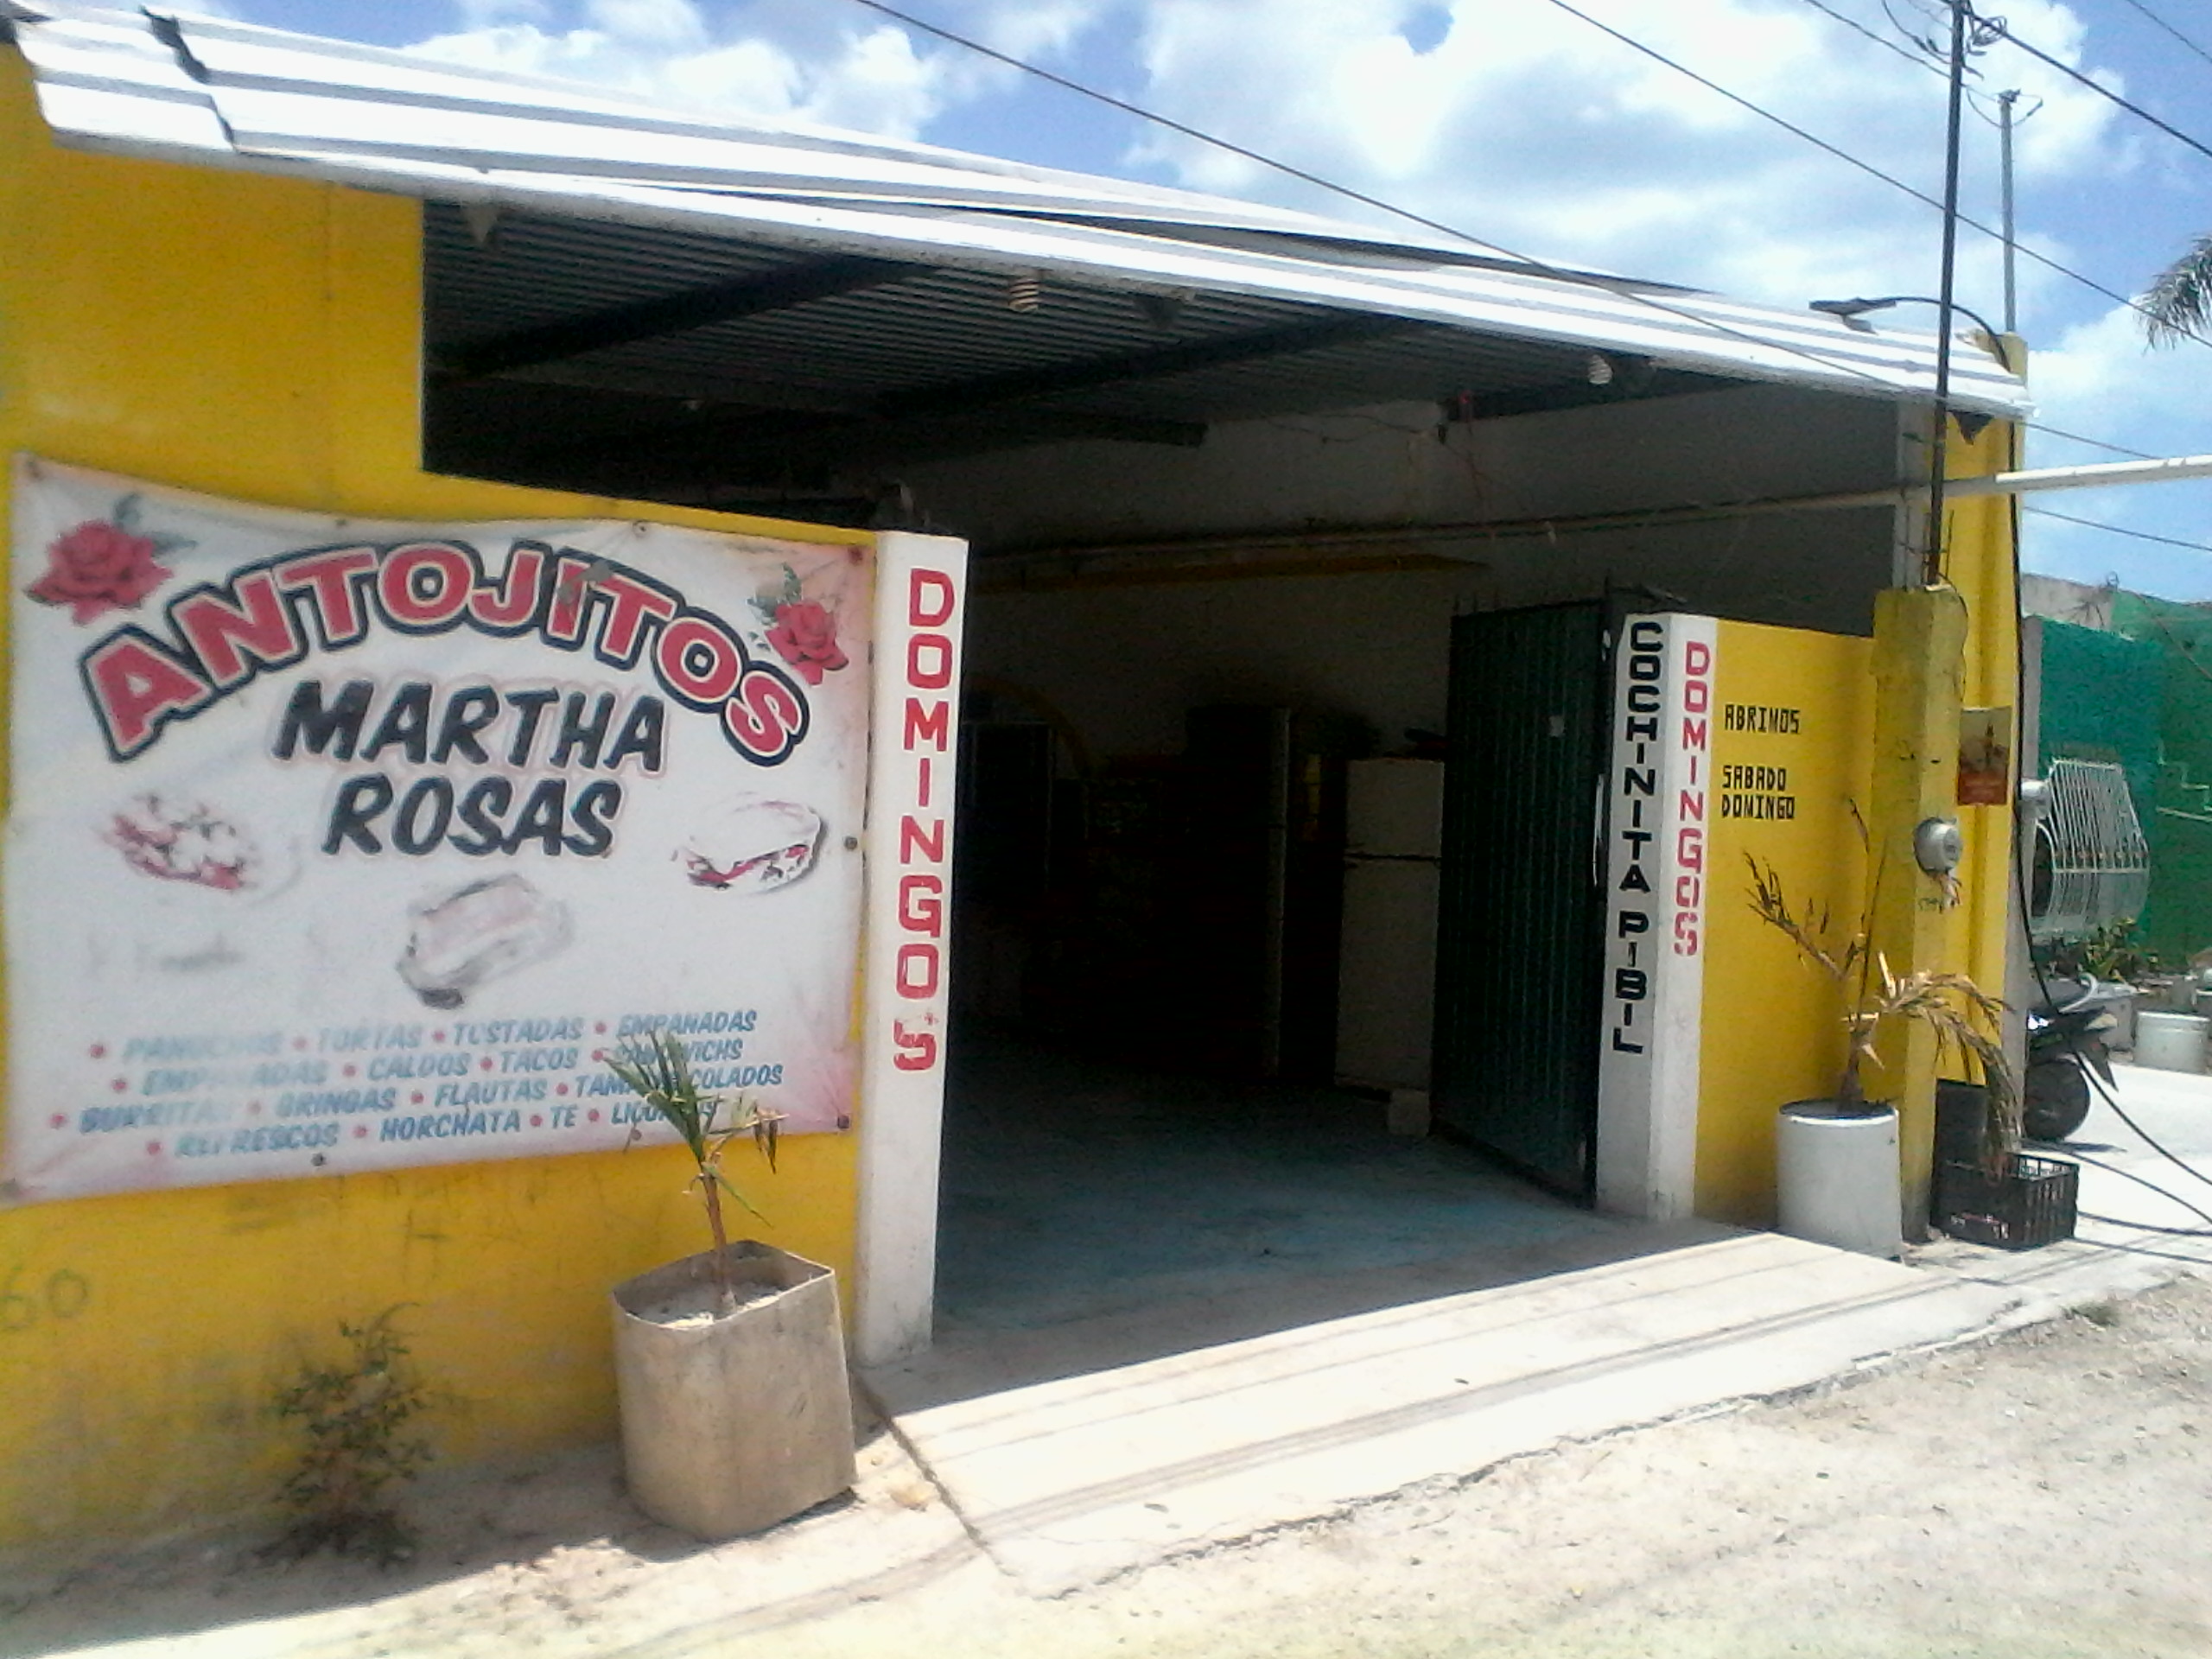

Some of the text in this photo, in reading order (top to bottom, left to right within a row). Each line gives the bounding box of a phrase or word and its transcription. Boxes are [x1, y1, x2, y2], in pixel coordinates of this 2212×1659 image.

[81, 539, 810, 766] ANTOJITOS
[271, 679, 664, 772] MARTHA
[1724, 702, 1802, 735] ABRIMOS
[1674, 640, 1711, 957] DOMINGOS
[1721, 764, 1788, 792] SABADO
[321, 773, 621, 857] ROSAS
[893, 568, 956, 1071] DOMINGOS
[1720, 792, 1796, 822] DOMINGO
[1612, 620, 1663, 1054] COCHINITA PIBIL
[615, 1008, 758, 1037] EMPANADAS
[367, 1052, 472, 1082] CALDOS
[500, 1046, 580, 1074] TACOS
[435, 1077, 549, 1108] FLAUTAS
[378, 1108, 521, 1144] HORCHATA
[550, 1103, 579, 1128] TE
